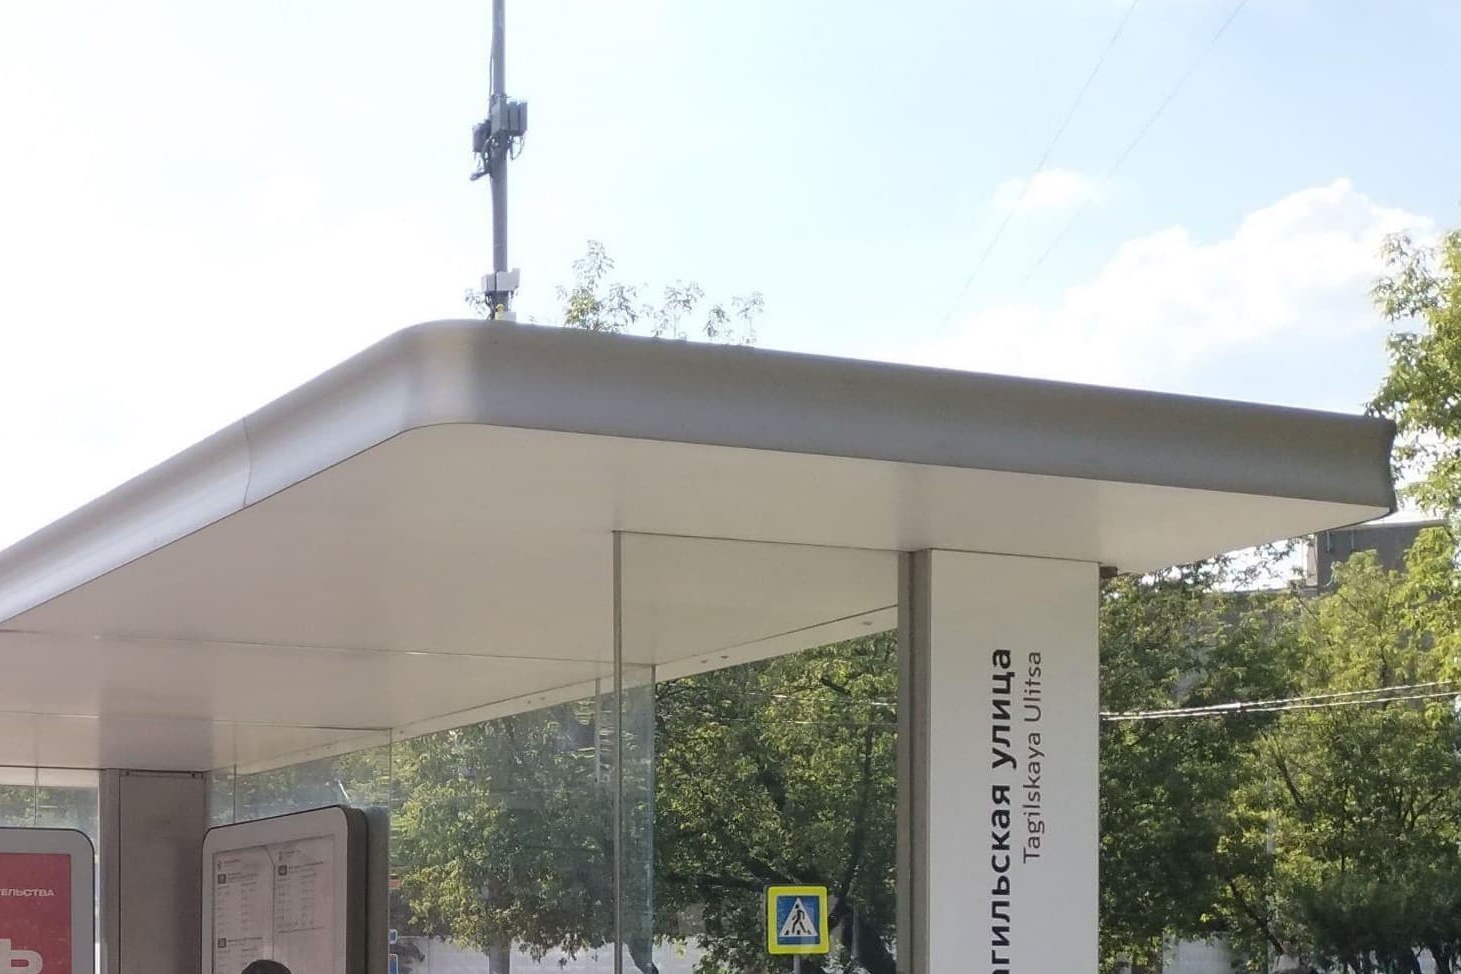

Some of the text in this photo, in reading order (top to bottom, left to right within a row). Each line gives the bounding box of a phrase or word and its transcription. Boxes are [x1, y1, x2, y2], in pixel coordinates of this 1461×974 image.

[991, 648, 1017, 770] улица
[1023, 651, 1045, 864] Tagilskaya Ulitsa
